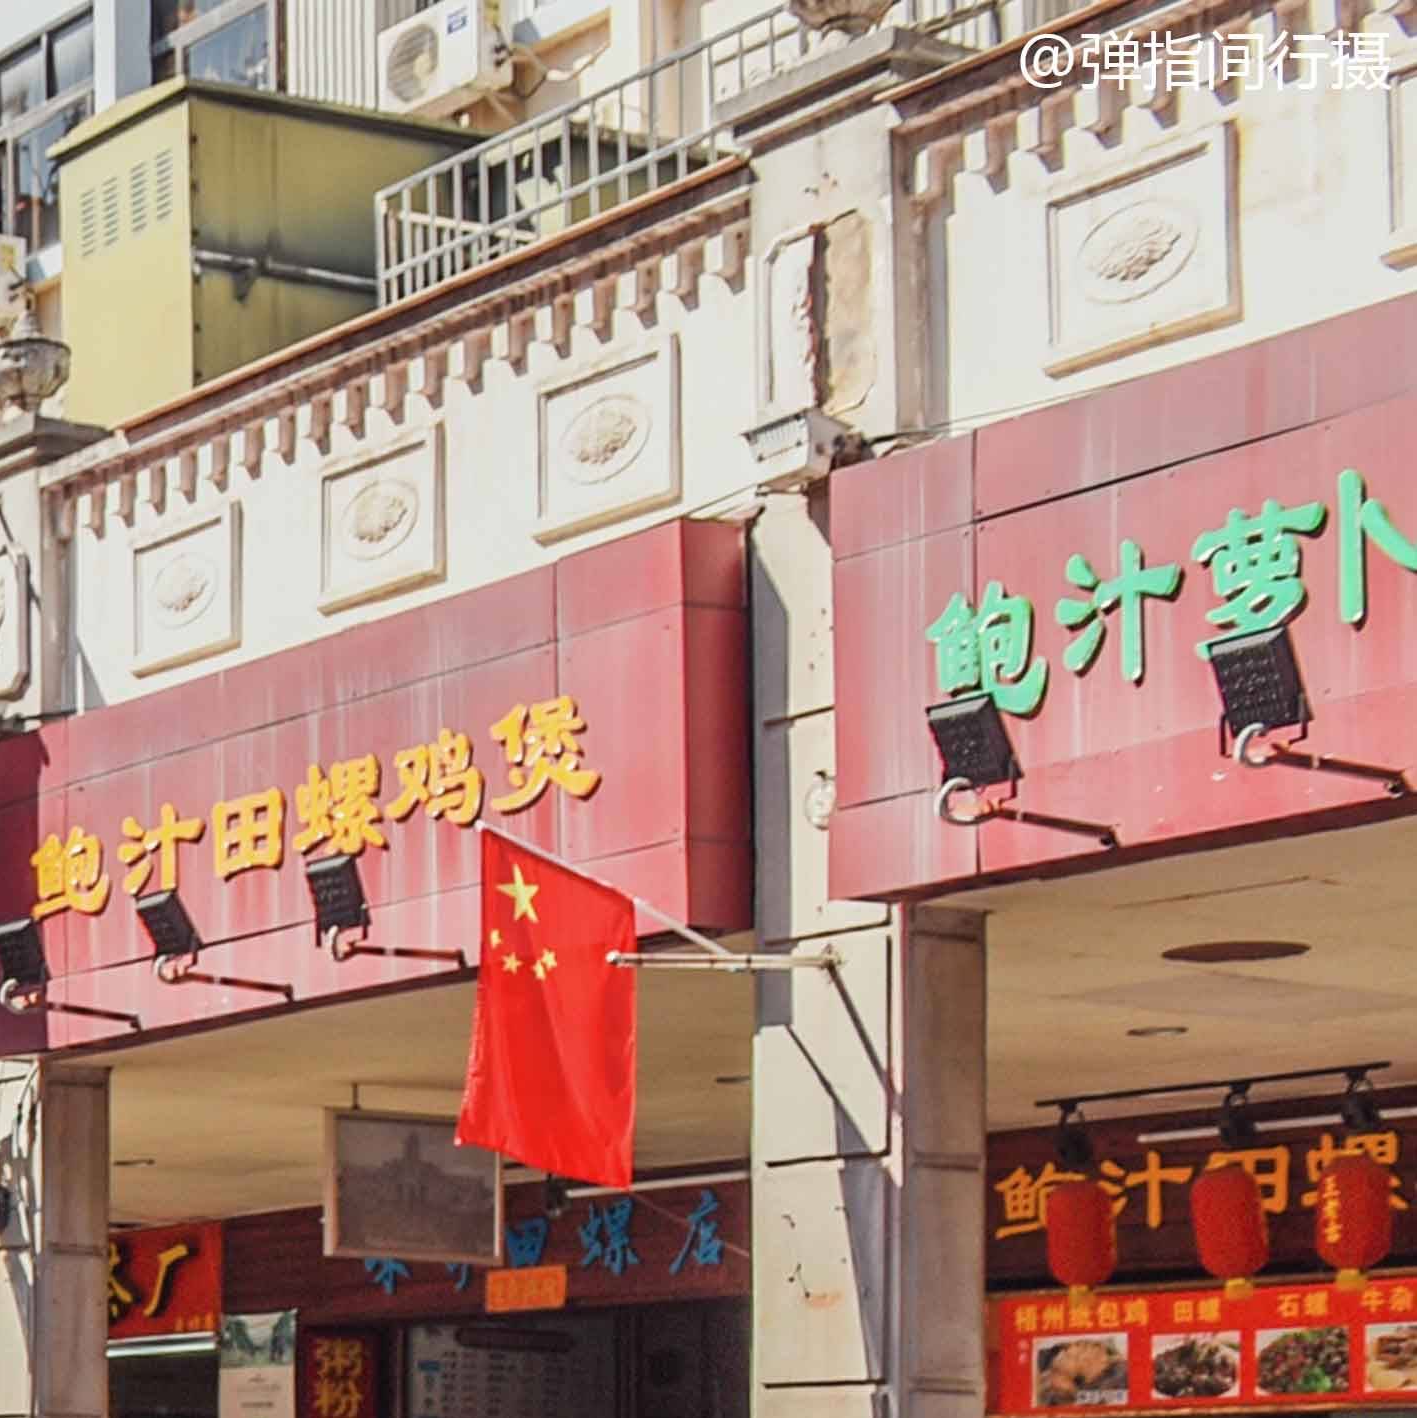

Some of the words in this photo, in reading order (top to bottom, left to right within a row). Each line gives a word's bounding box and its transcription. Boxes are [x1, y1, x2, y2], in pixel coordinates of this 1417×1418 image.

[31, 694, 602, 921] 鲍汁田螺鸡煲
[1172, 1297, 1222, 1323] 田螺
